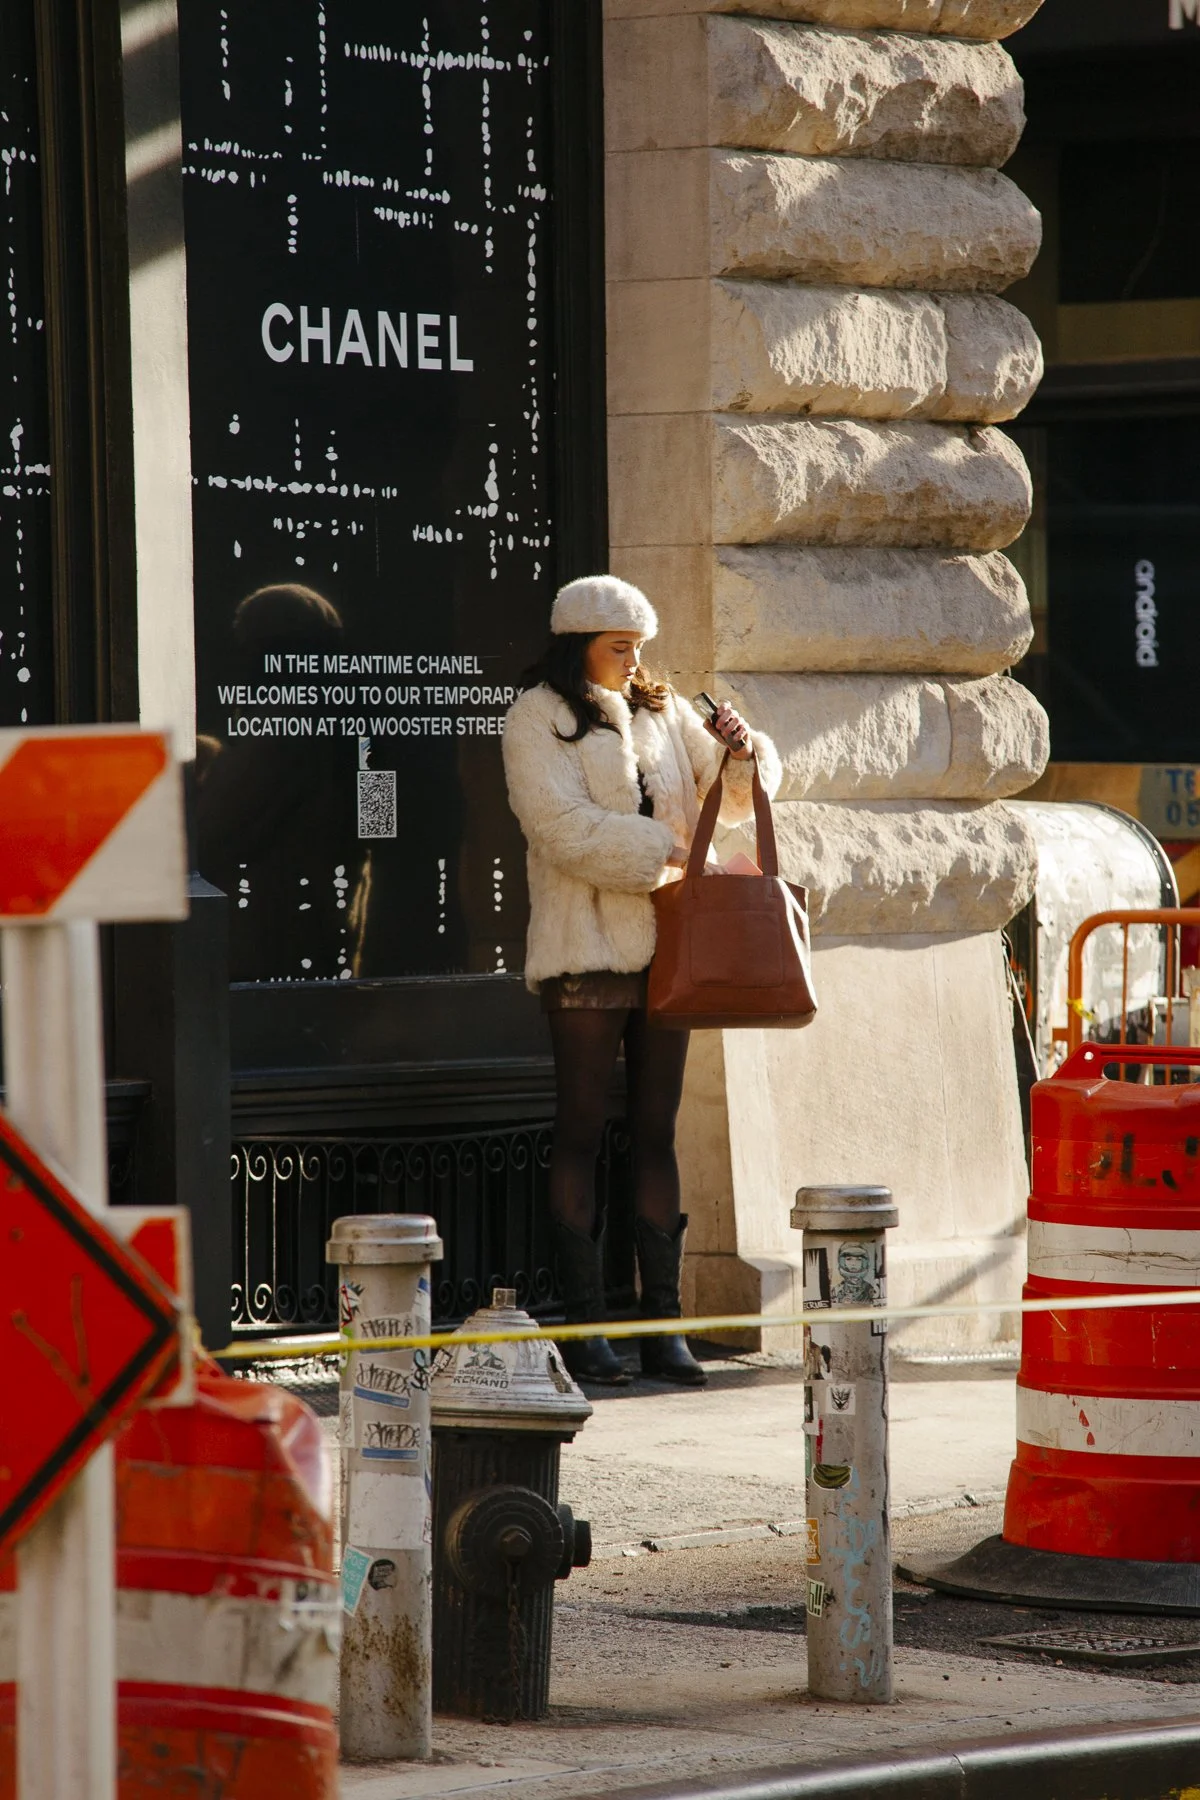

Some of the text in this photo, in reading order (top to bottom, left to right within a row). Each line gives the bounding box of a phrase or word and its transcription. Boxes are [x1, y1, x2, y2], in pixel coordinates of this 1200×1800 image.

[261, 302, 474, 372] CHANEL
[1135, 559, 1159, 667] android
[265, 654, 483, 674] IN THE MEANTIME CHANEL
[217, 685, 318, 705] WELCOMES
[321, 686, 356, 705] YOU
[359, 686, 381, 705] TO
[385, 686, 420, 705] OUR
[228, 717, 506, 736] LOCATION AT 120 WOOSTER STREE
